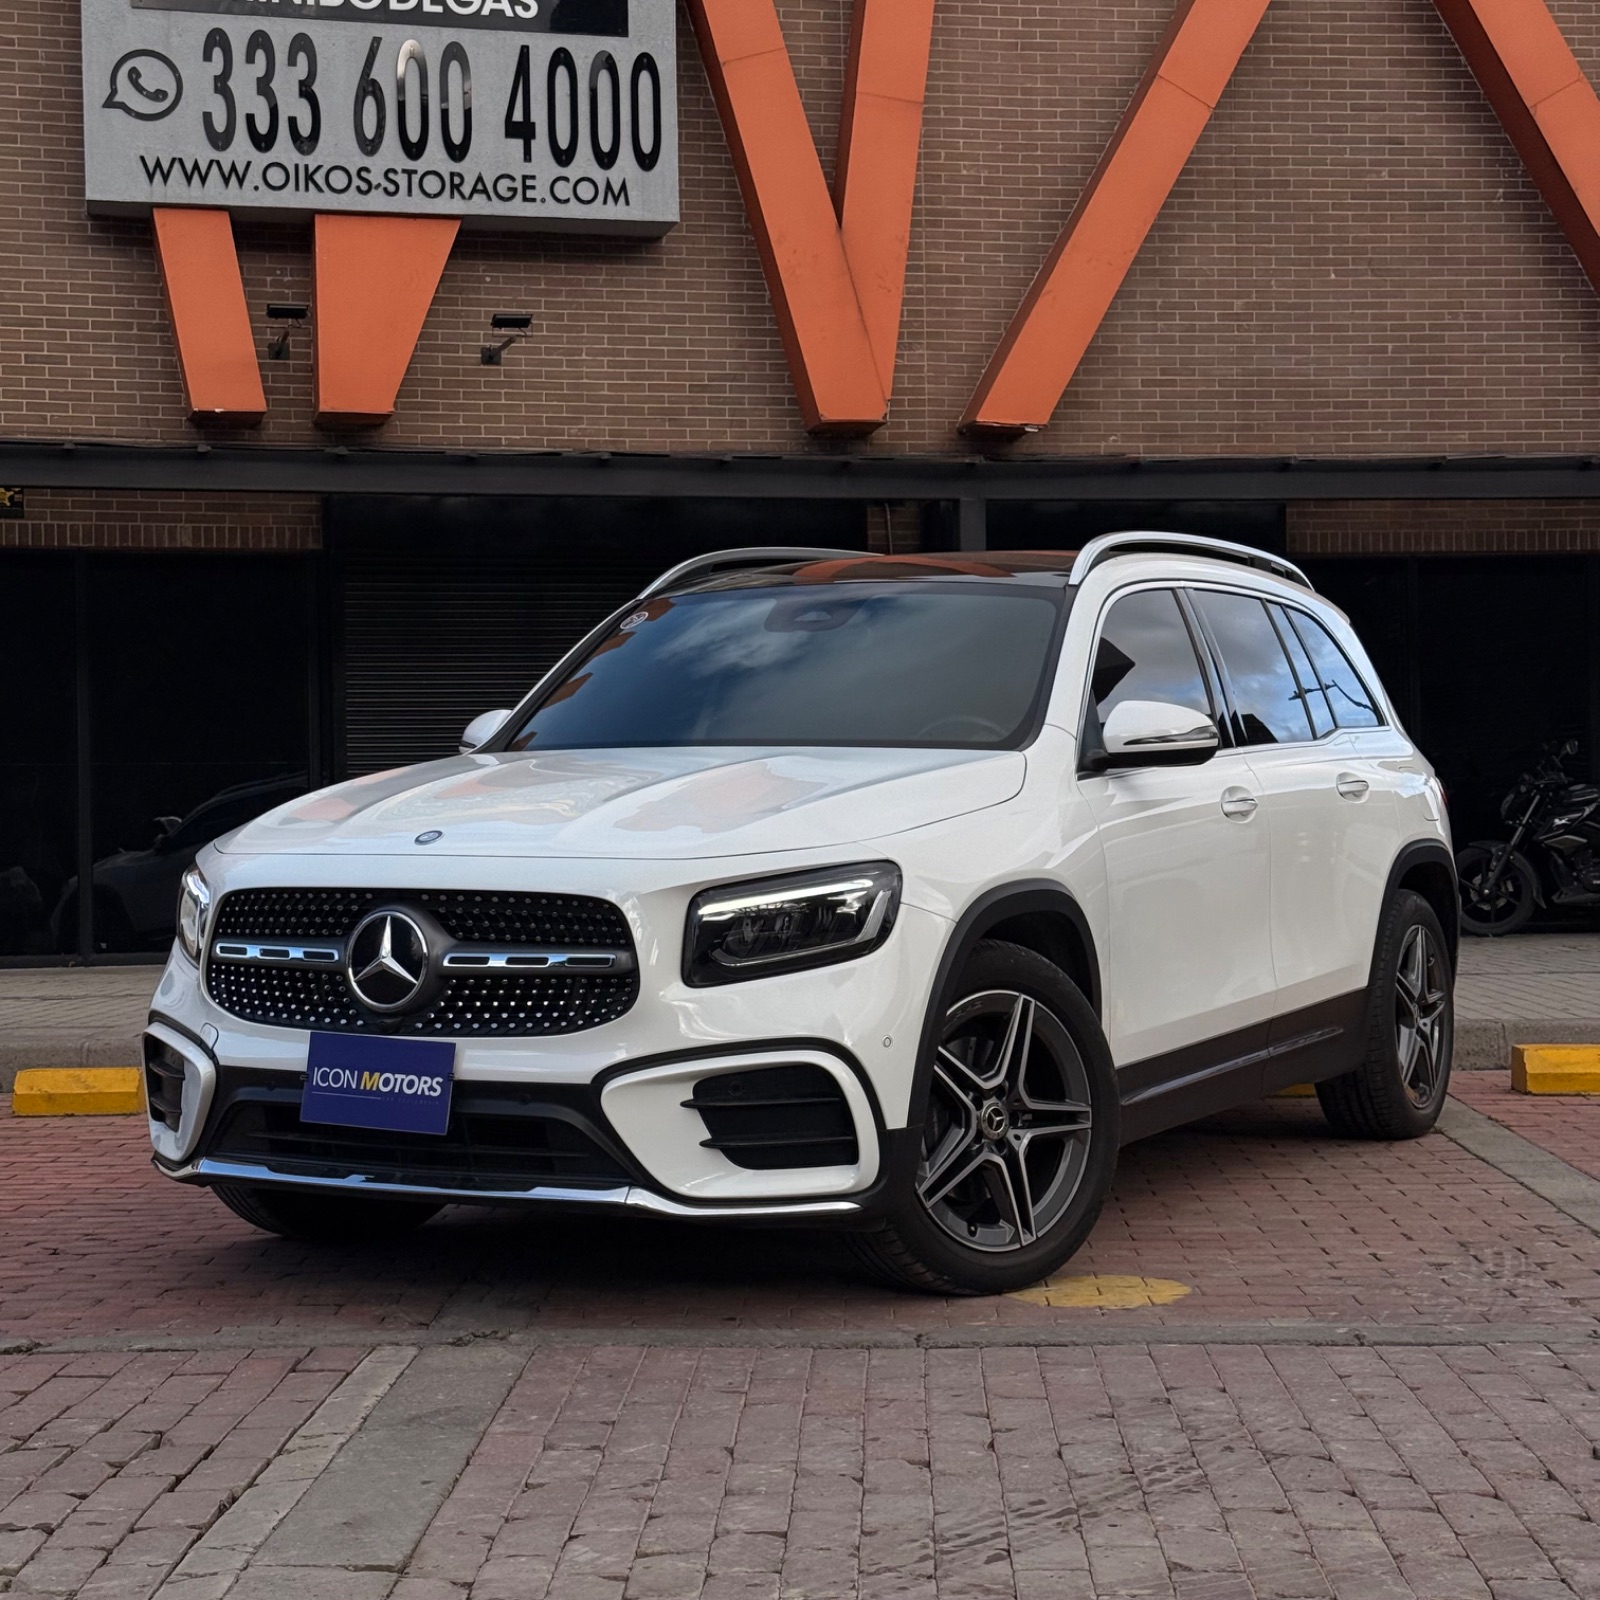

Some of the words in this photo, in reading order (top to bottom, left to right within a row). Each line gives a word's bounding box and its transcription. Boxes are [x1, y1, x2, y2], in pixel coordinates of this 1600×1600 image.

[202, 27, 321, 156] 333
[353, 36, 472, 163] 600
[504, 45, 661, 172] 4000
[139, 155, 631, 207] WWW.OIKOS-STORAGE.COM
[312, 1066, 358, 1090] ICON
[360, 1071, 443, 1097] MOTORS
